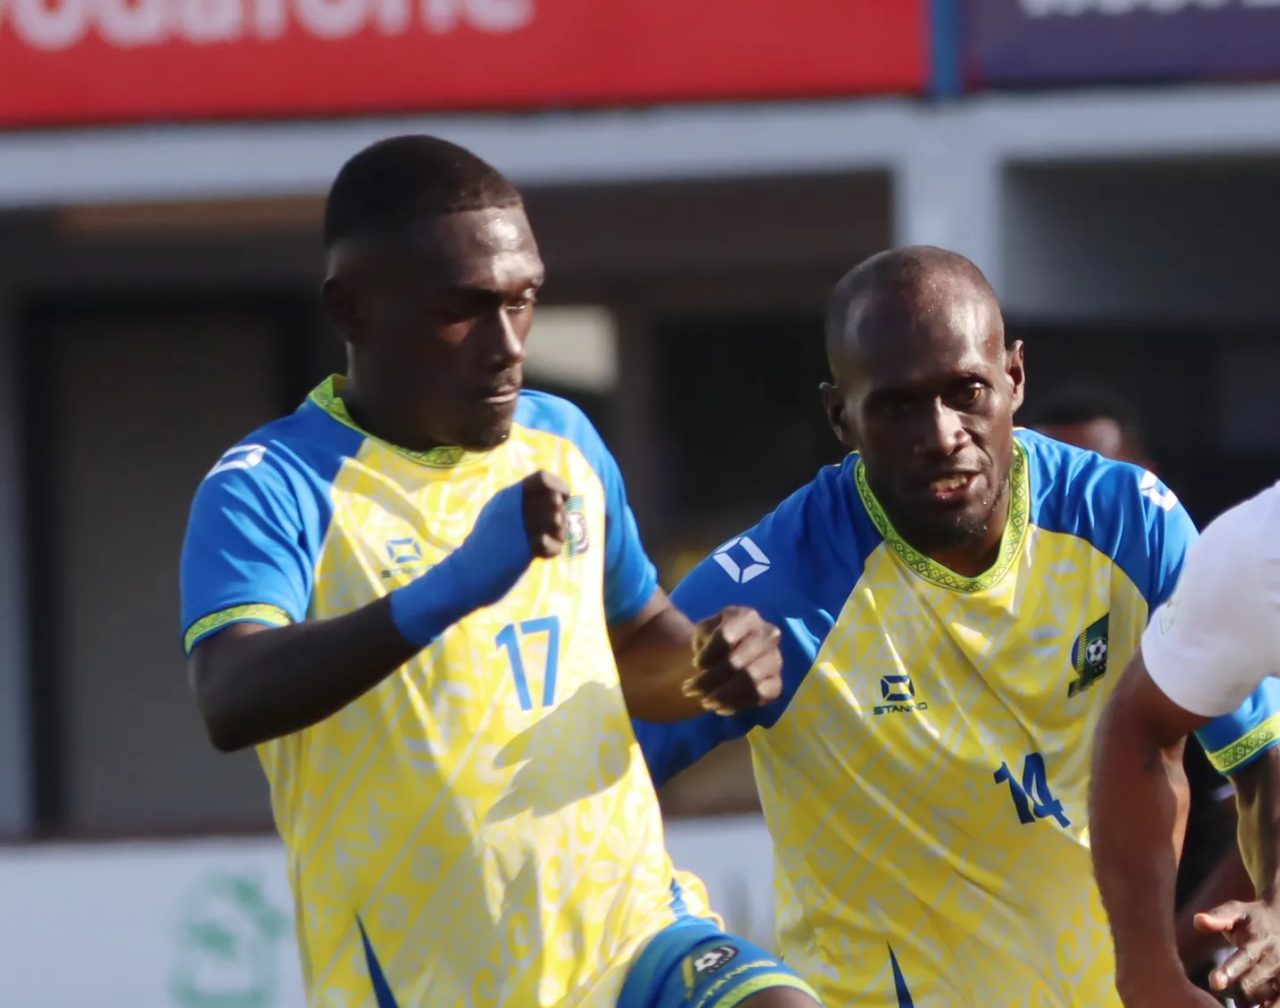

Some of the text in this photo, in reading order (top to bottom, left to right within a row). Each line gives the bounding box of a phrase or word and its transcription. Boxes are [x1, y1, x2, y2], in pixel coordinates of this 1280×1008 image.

[495, 615, 560, 711] 17
[873, 702, 928, 715] STANO
[994, 752, 1071, 829] 14
